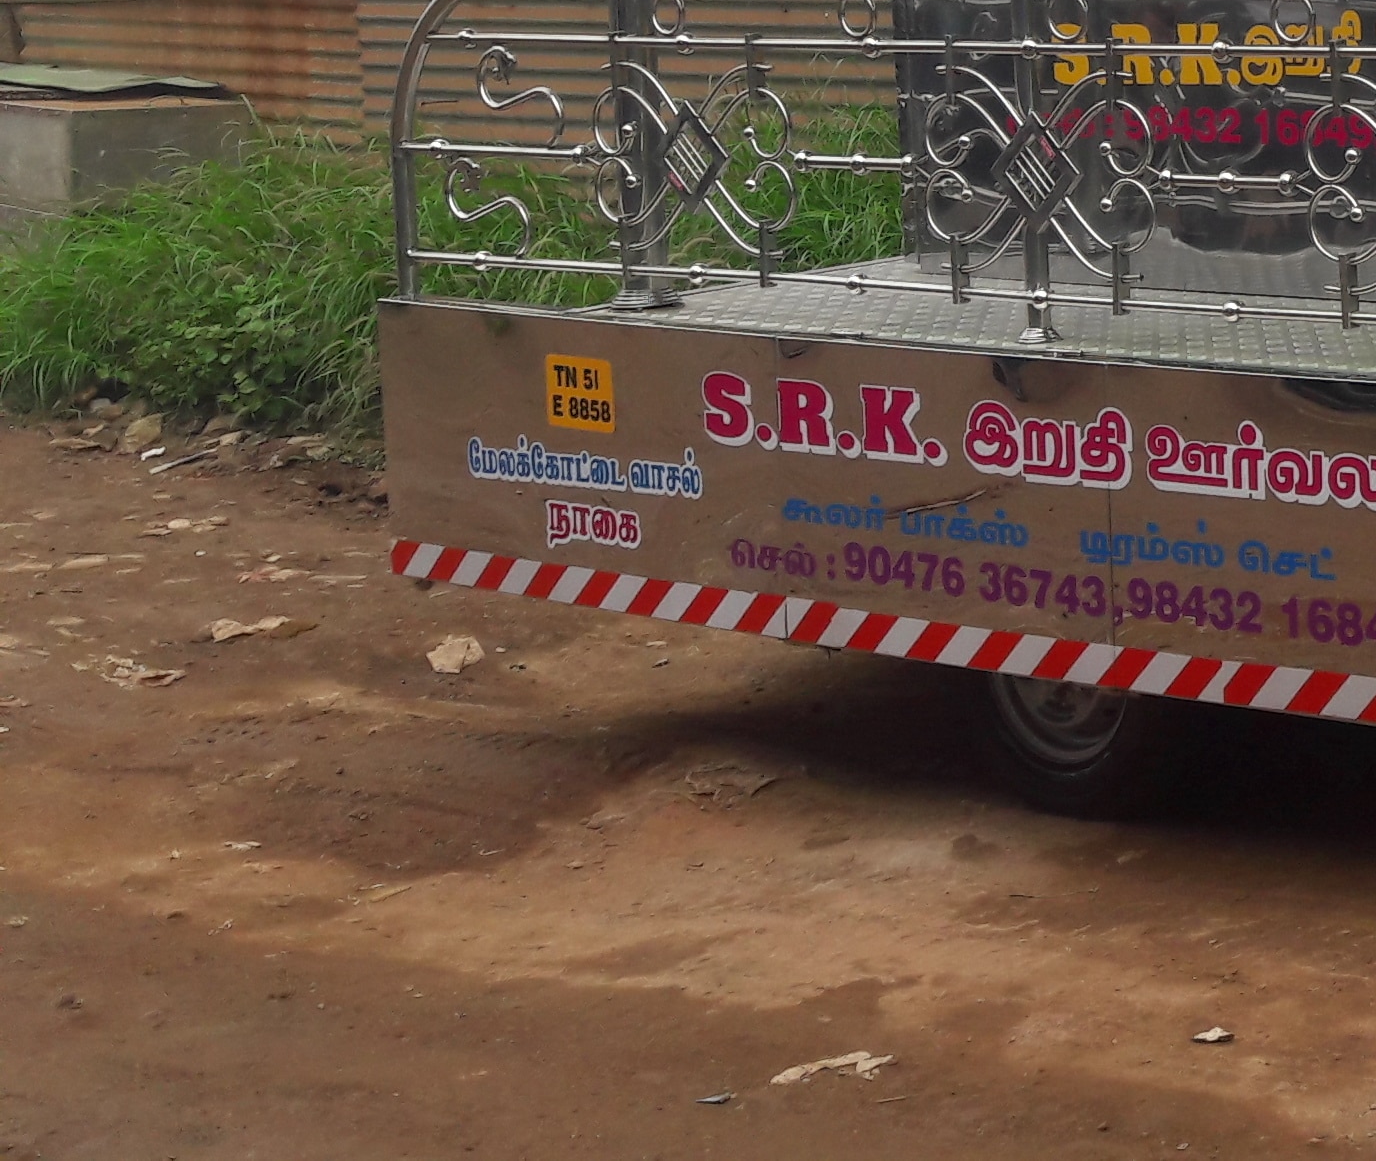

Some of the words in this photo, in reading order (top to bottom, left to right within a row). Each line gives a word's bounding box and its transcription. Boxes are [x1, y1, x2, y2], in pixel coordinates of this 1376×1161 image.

[554, 365, 577, 389] TN
[553, 395, 564, 417] E
[569, 399, 611, 423] 8858
[703, 372, 945, 464] S.R.K.
[965, 401, 1129, 485] இறுதி
[468, 436, 625, 485] மேலக்கோட்டை
[629, 450, 701, 495] வாசல்
[549, 501, 639, 545] நாகை
